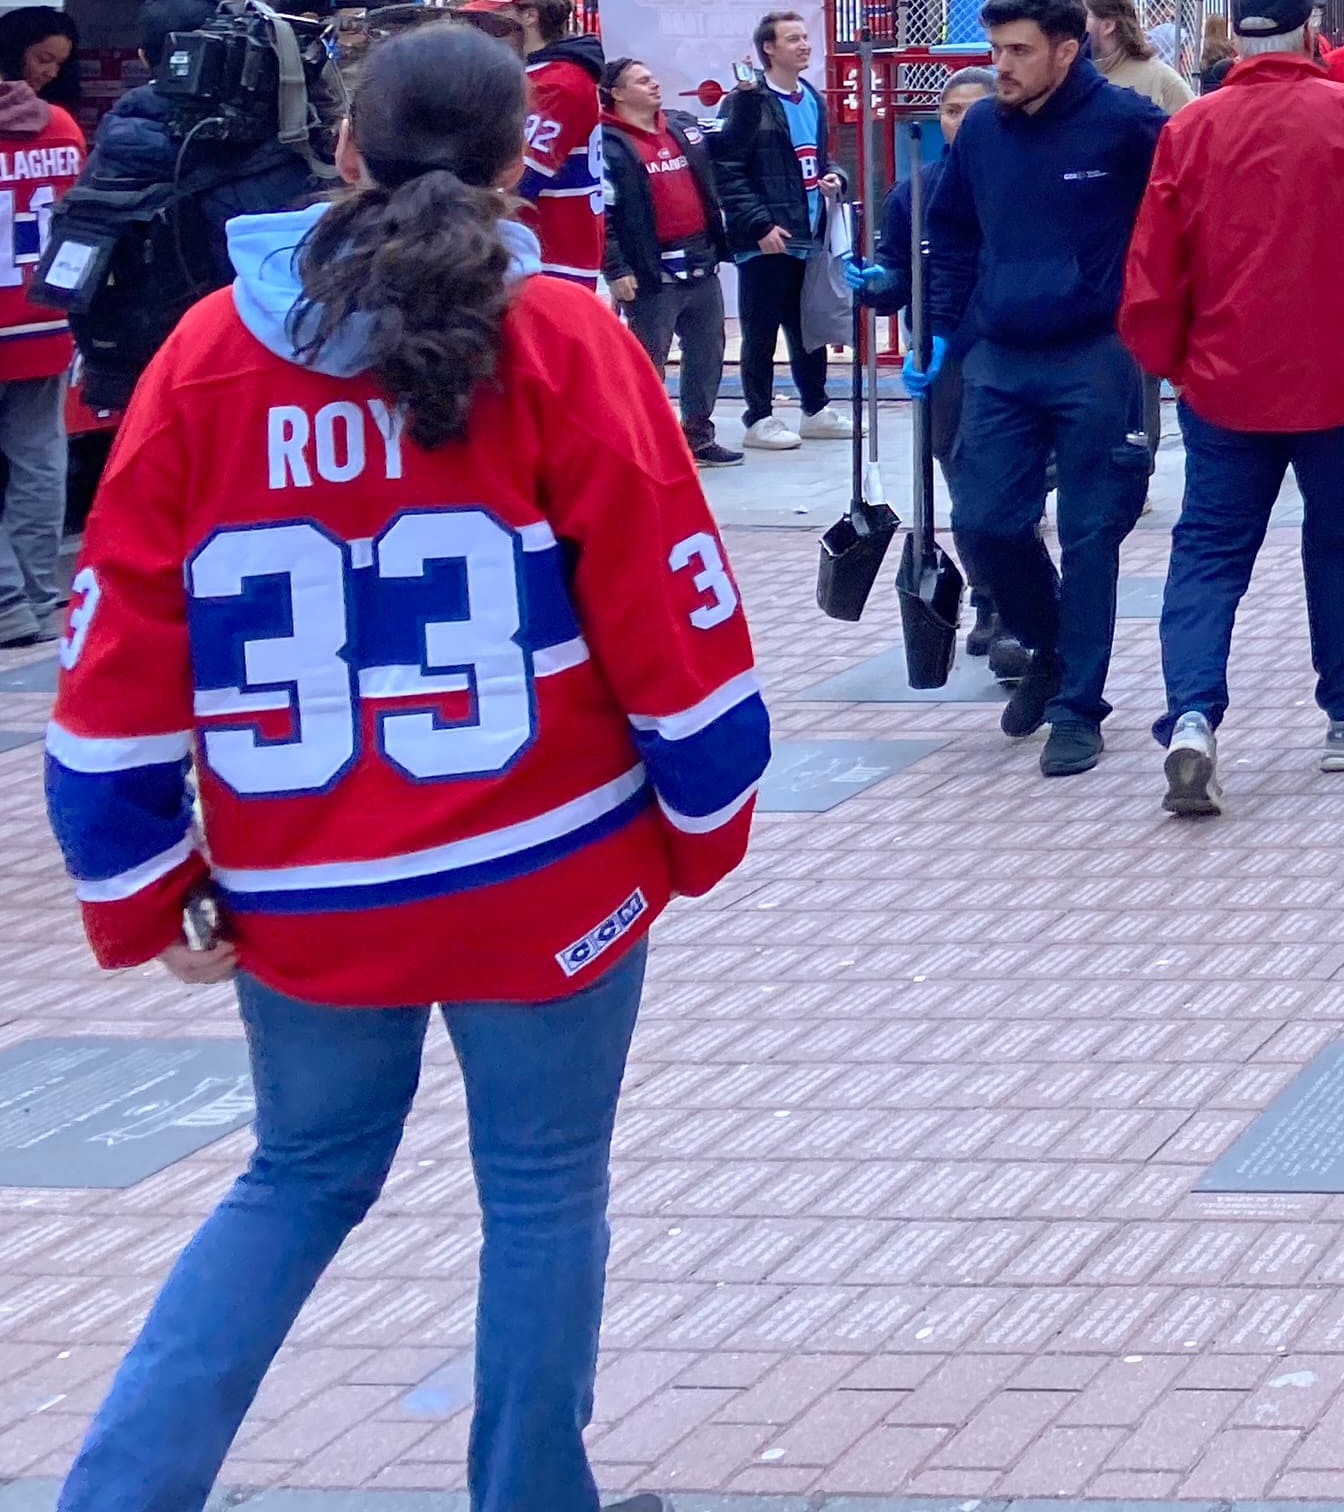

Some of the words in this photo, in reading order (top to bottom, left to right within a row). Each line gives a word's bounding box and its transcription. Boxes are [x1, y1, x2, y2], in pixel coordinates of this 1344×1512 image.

[267, 399, 405, 490] ROY
[668, 531, 740, 631] 3
[184, 506, 538, 799] 33
[558, 892, 644, 968] CCM
